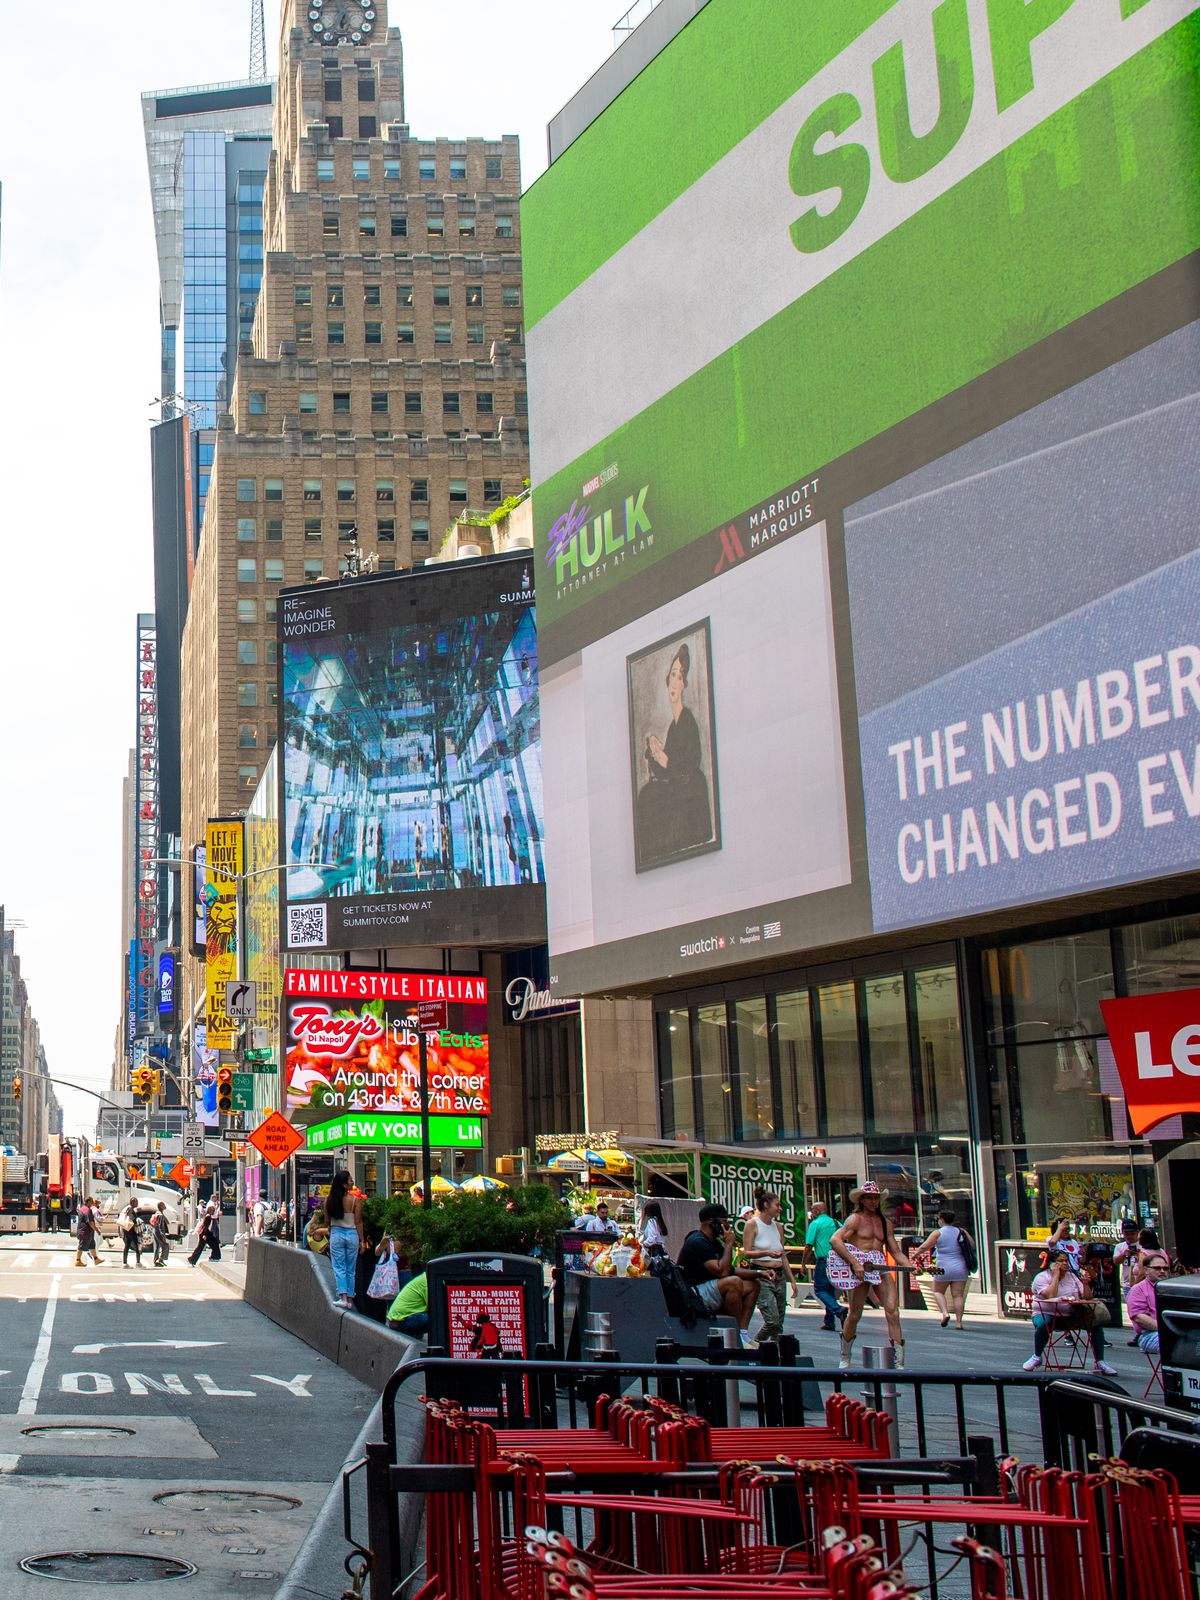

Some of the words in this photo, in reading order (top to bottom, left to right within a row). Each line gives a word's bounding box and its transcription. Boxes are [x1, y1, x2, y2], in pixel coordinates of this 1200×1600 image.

[749, 478, 820, 529] MARRIOTT
[555, 484, 652, 586] HULK
[750, 504, 813, 548] MARQUIS
[557, 562, 607, 600] ATTORNEY
[614, 552, 625, 565] AT
[633, 534, 654, 555] LAW
[284, 607, 332, 624] IMAGINE
[284, 620, 336, 636] WONDER
[888, 721, 973, 800] THE
[898, 771, 1122, 884] CHANGED
[211, 831, 227, 846] LET
[230, 831, 237, 846] IT
[211, 847, 237, 862] MOVE
[211, 863, 237, 883] YOU
[343, 905, 360, 915] GET
[361, 903, 397, 913] TICKETS
[399, 901, 419, 912] NOW
[420, 901, 433, 910] AT
[343, 916, 409, 927] SUMMITOV.COM
[680, 937, 718, 957] swatch
[288, 972, 410, 997] FAMILY-STYLE
[419, 979, 485, 1000] ITALIAN
[292, 1006, 381, 1042] Tony's
[393, 1020, 418, 1028] ONLY
[319, 1035, 344, 1044] Napoli
[440, 1030, 483, 1048] Eats
[333, 1067, 398, 1087] Around
[431, 1072, 486, 1090] corner
[323, 1093, 345, 1106] on
[349, 1089, 387, 1107] 43rd
[391, 1091, 406, 1108] st.
[411, 1091, 421, 1107] &
[426, 1091, 452, 1109] 7th
[454, 1095, 487, 1111] ave.
[186, 1136, 202, 1147] 25
[709, 1164, 794, 1184] DISCOVER
[70, 1293, 207, 1303] ONLY
[61, 1372, 313, 1397] ONLY
